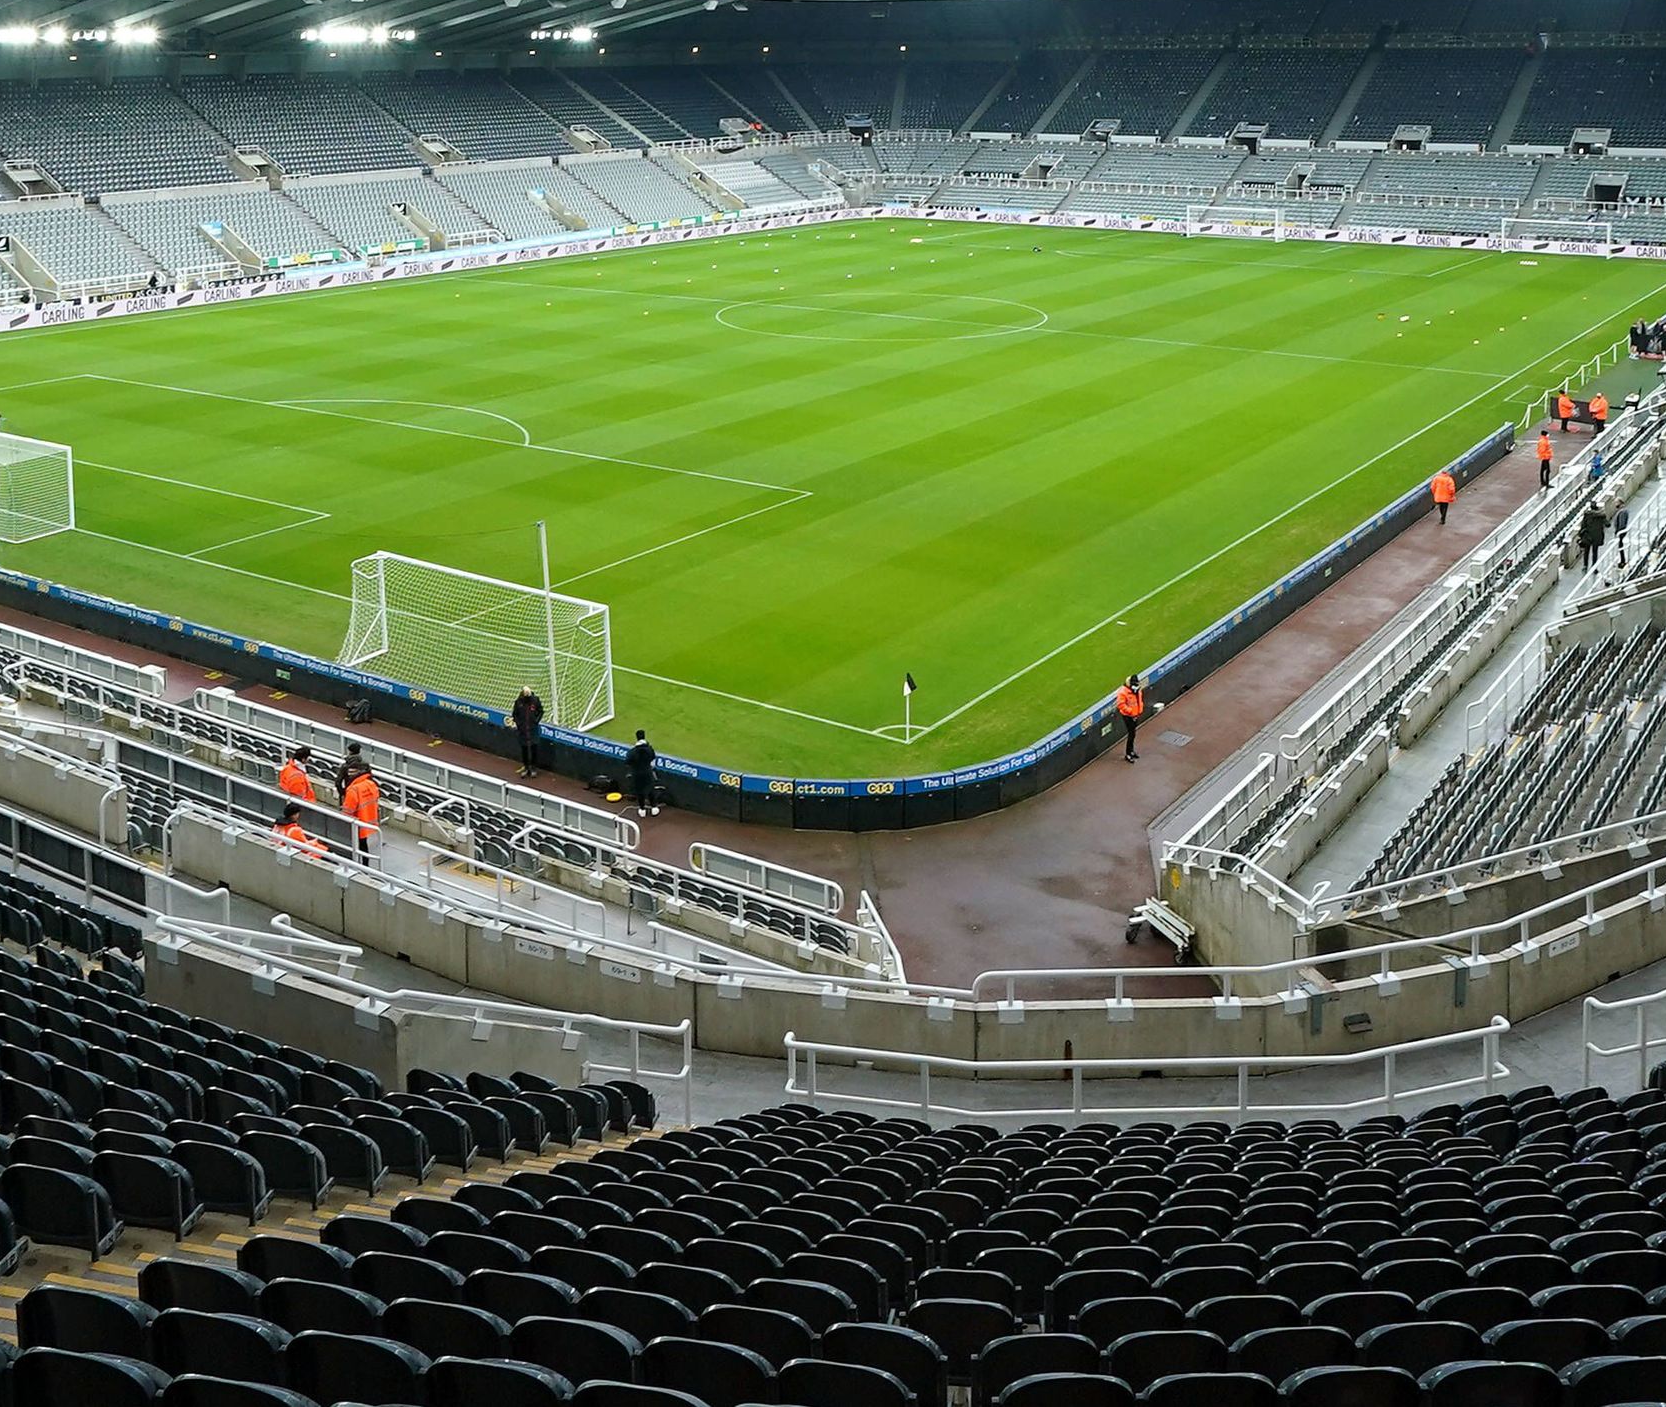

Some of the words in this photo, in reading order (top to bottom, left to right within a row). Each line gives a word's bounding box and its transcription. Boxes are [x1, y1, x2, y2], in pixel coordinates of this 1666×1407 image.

[1161, 221, 1190, 231] CARLIN
[1416, 235, 1450, 247] CARLING
[1559, 242, 1597, 254] CARLING
[342, 270, 374, 284] CARLING
[276, 278, 310, 293] CARLING
[204, 287, 241, 302] CARLING
[126, 296, 166, 313] CARLING
[42, 307, 85, 325] CARLING
[541, 725, 553, 737] The
[554, 729, 583, 746] Ultimate
[584, 737, 613, 754] Solution
[614, 745, 627, 757] For
[657, 757, 664, 767] &
[664, 759, 698, 777] Bonding
[923, 778, 939, 789] The
[978, 762, 1009, 781] Solution
[1011, 758, 1022, 770] For
